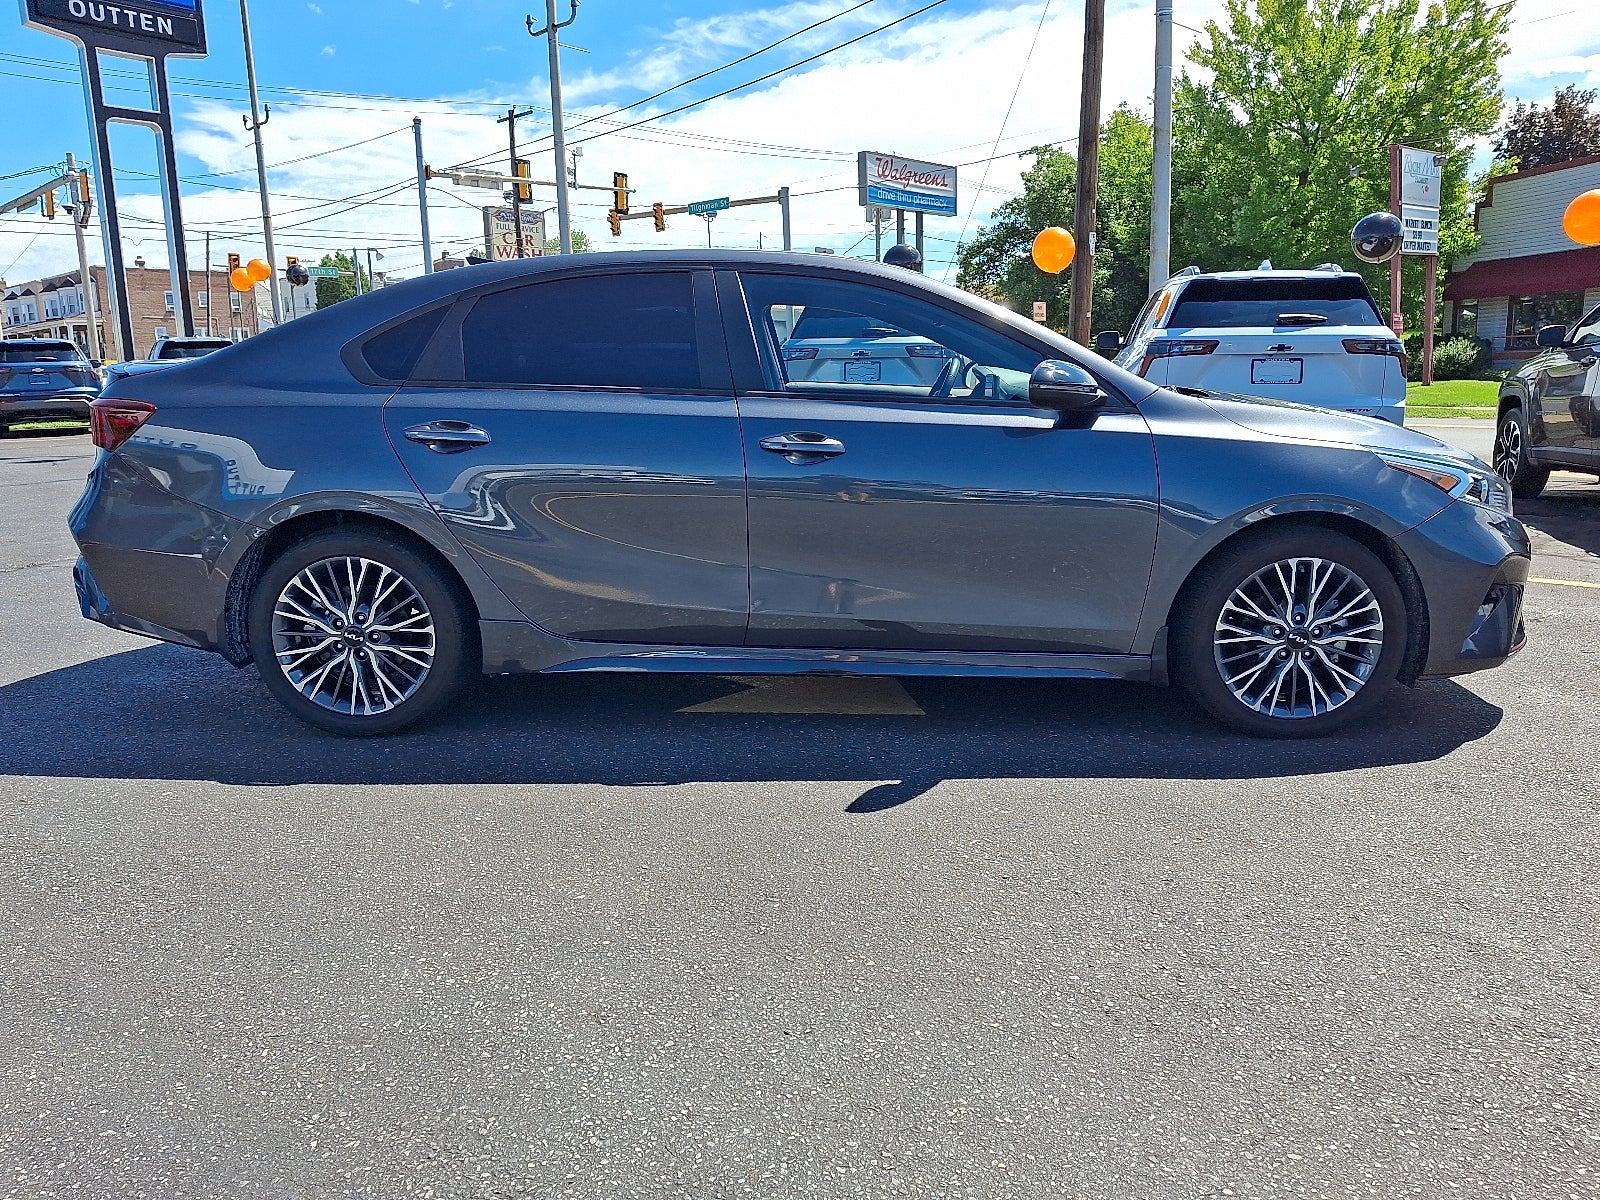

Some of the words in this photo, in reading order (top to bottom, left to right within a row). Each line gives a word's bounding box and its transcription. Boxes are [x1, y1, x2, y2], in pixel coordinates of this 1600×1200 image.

[69, 0, 173, 36] OUTTEN
[875, 156, 949, 189] Walgreens
[690, 202, 718, 213] Tilghman
[720, 199, 728, 208] St
[877, 187, 896, 202] drive
[897, 190, 912, 203] thru
[913, 193, 948, 210] pharmacy
[496, 223, 511, 231] FULL
[502, 231, 534, 247] CR
[310, 267, 326, 275] 17th
